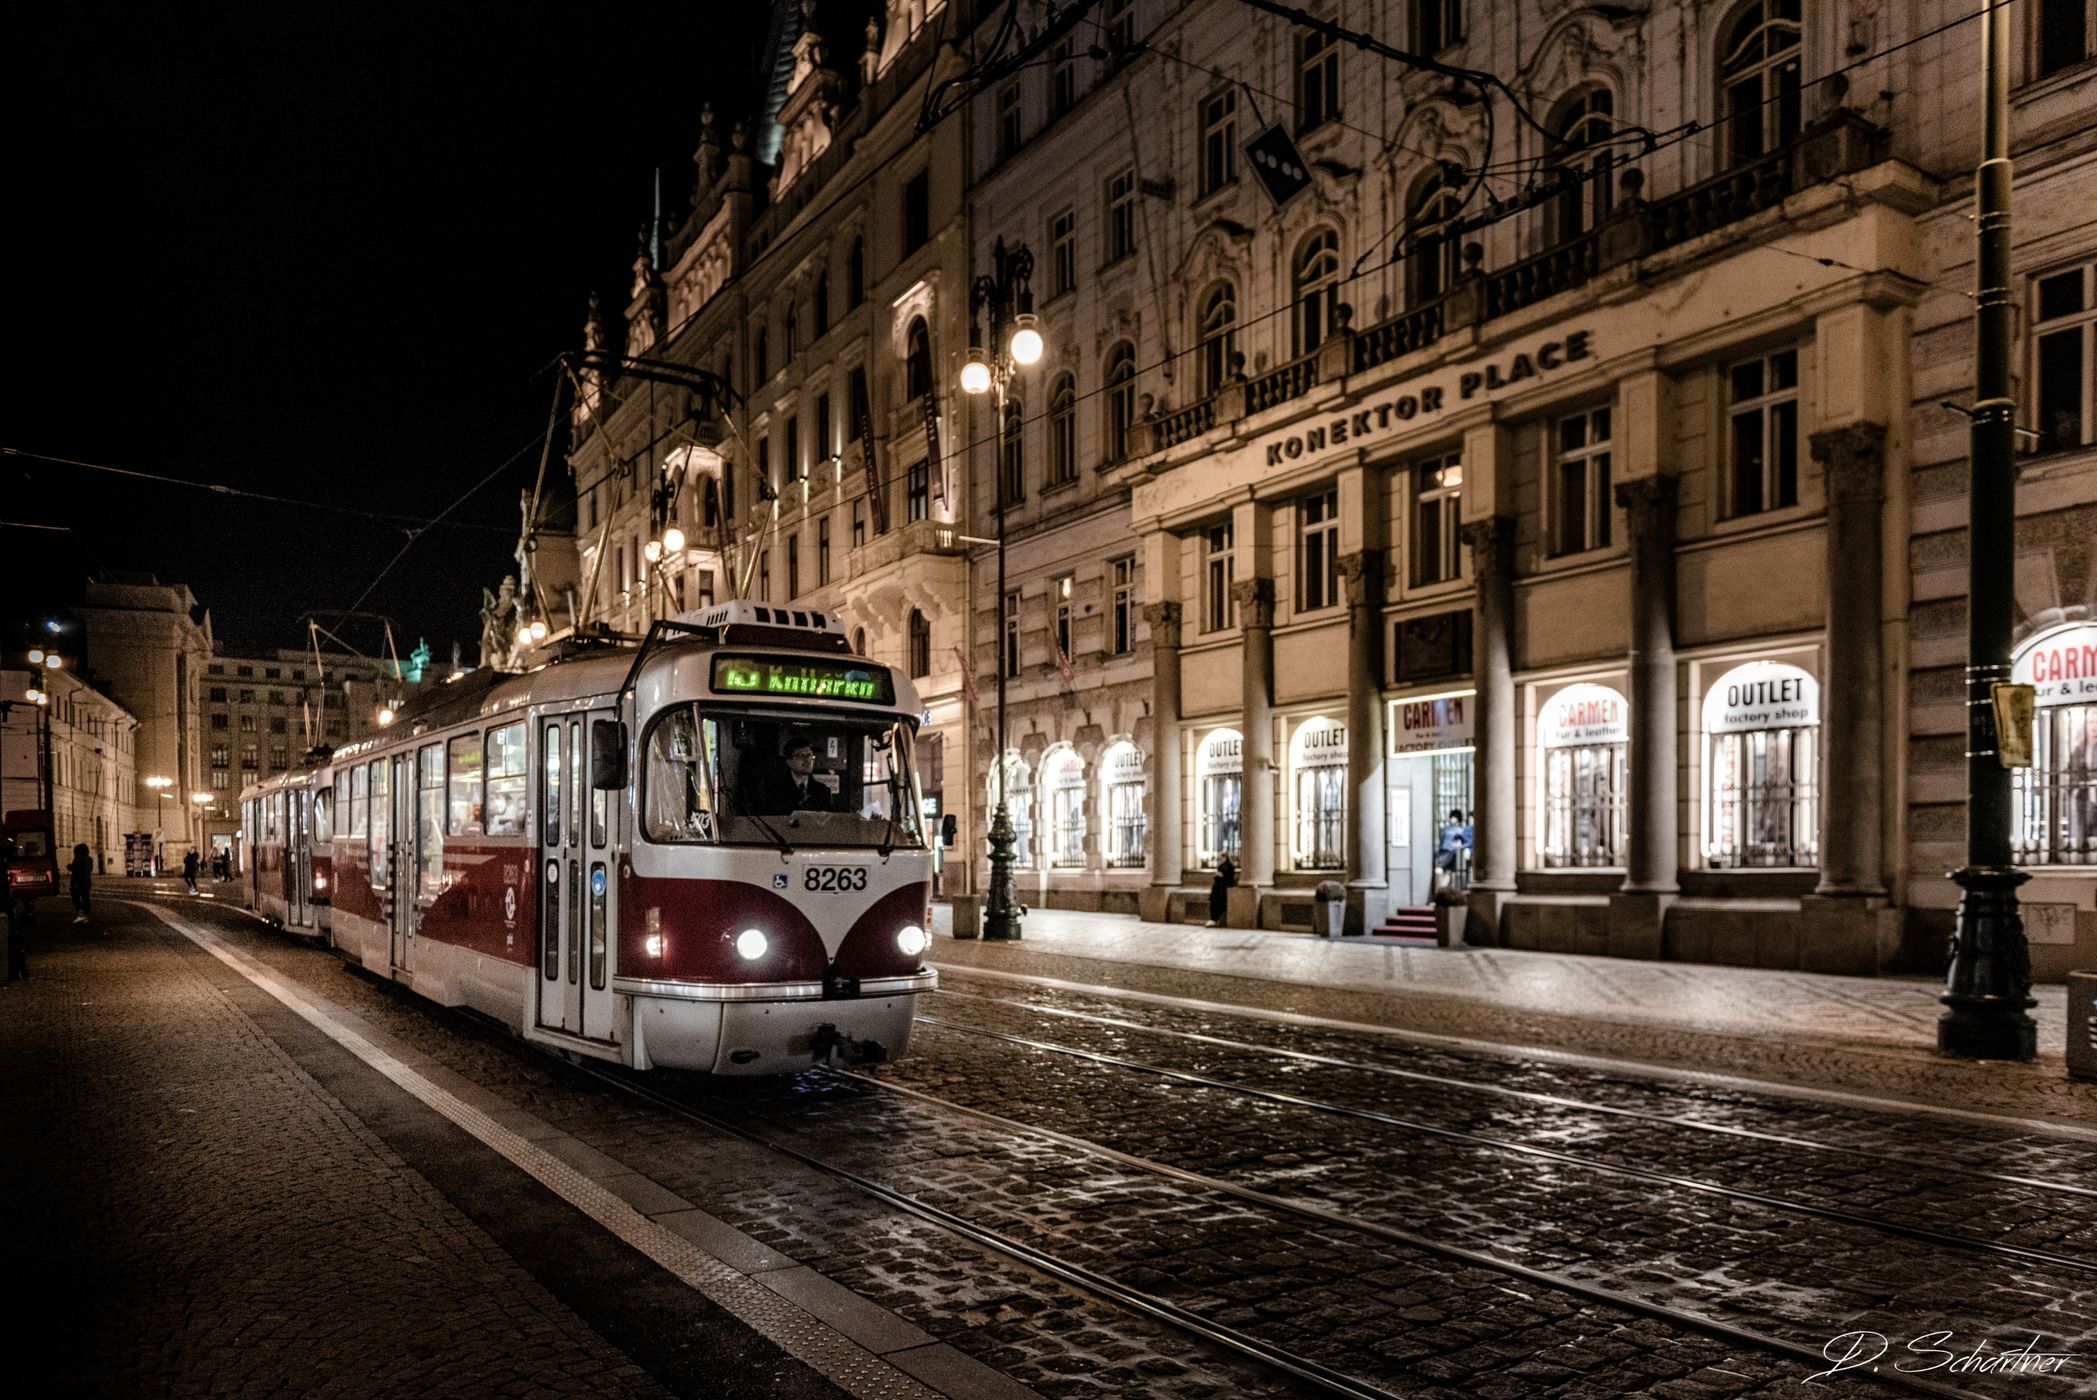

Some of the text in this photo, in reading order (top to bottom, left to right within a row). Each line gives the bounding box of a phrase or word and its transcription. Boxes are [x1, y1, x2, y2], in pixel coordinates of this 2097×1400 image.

[1266, 329, 1595, 467] KONEKTOR PLACE
[1728, 678, 1804, 707] OUTLET
[2061, 682, 2071, 695] &
[1560, 699, 1618, 727] CARMEN
[1725, 706, 1808, 724] factory shop
[1305, 727, 1345, 748] OUTLET
[804, 867, 868, 892] 8263
